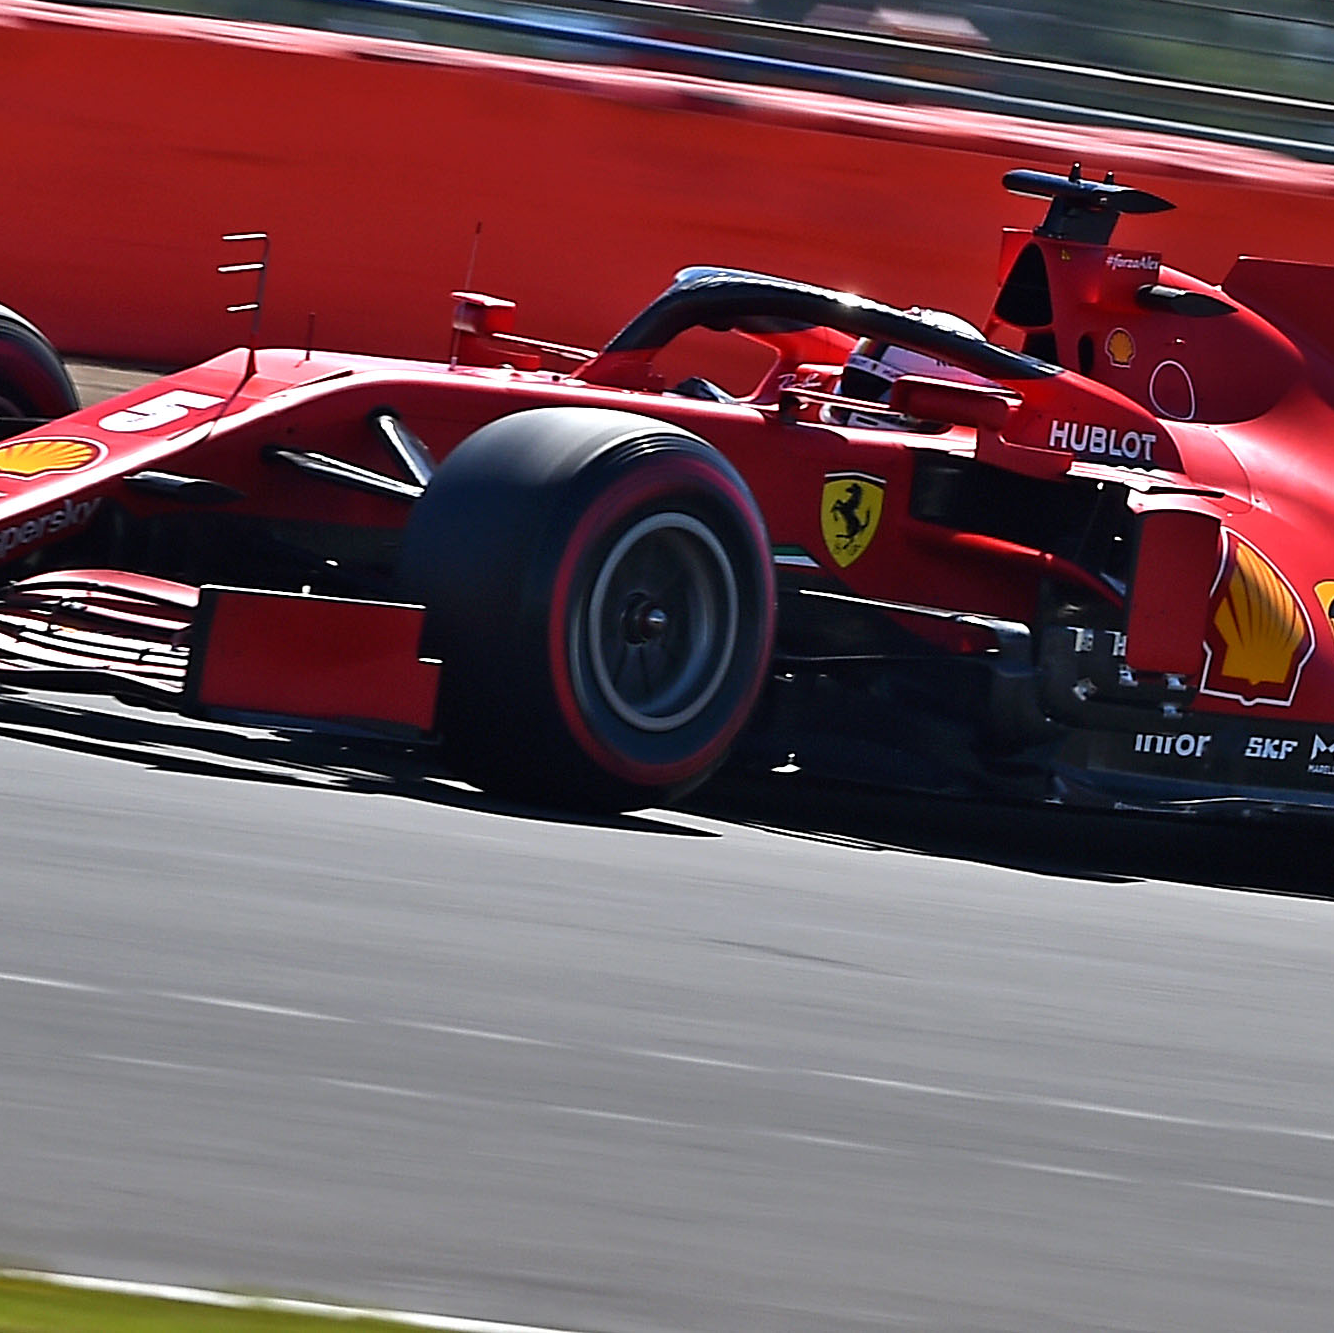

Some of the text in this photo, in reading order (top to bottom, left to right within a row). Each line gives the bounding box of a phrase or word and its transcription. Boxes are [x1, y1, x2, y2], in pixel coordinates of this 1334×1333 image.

[98, 389, 226, 433] 5
[1049, 420, 1157, 461] HUBLOT
[1244, 736, 1299, 760] SKF
